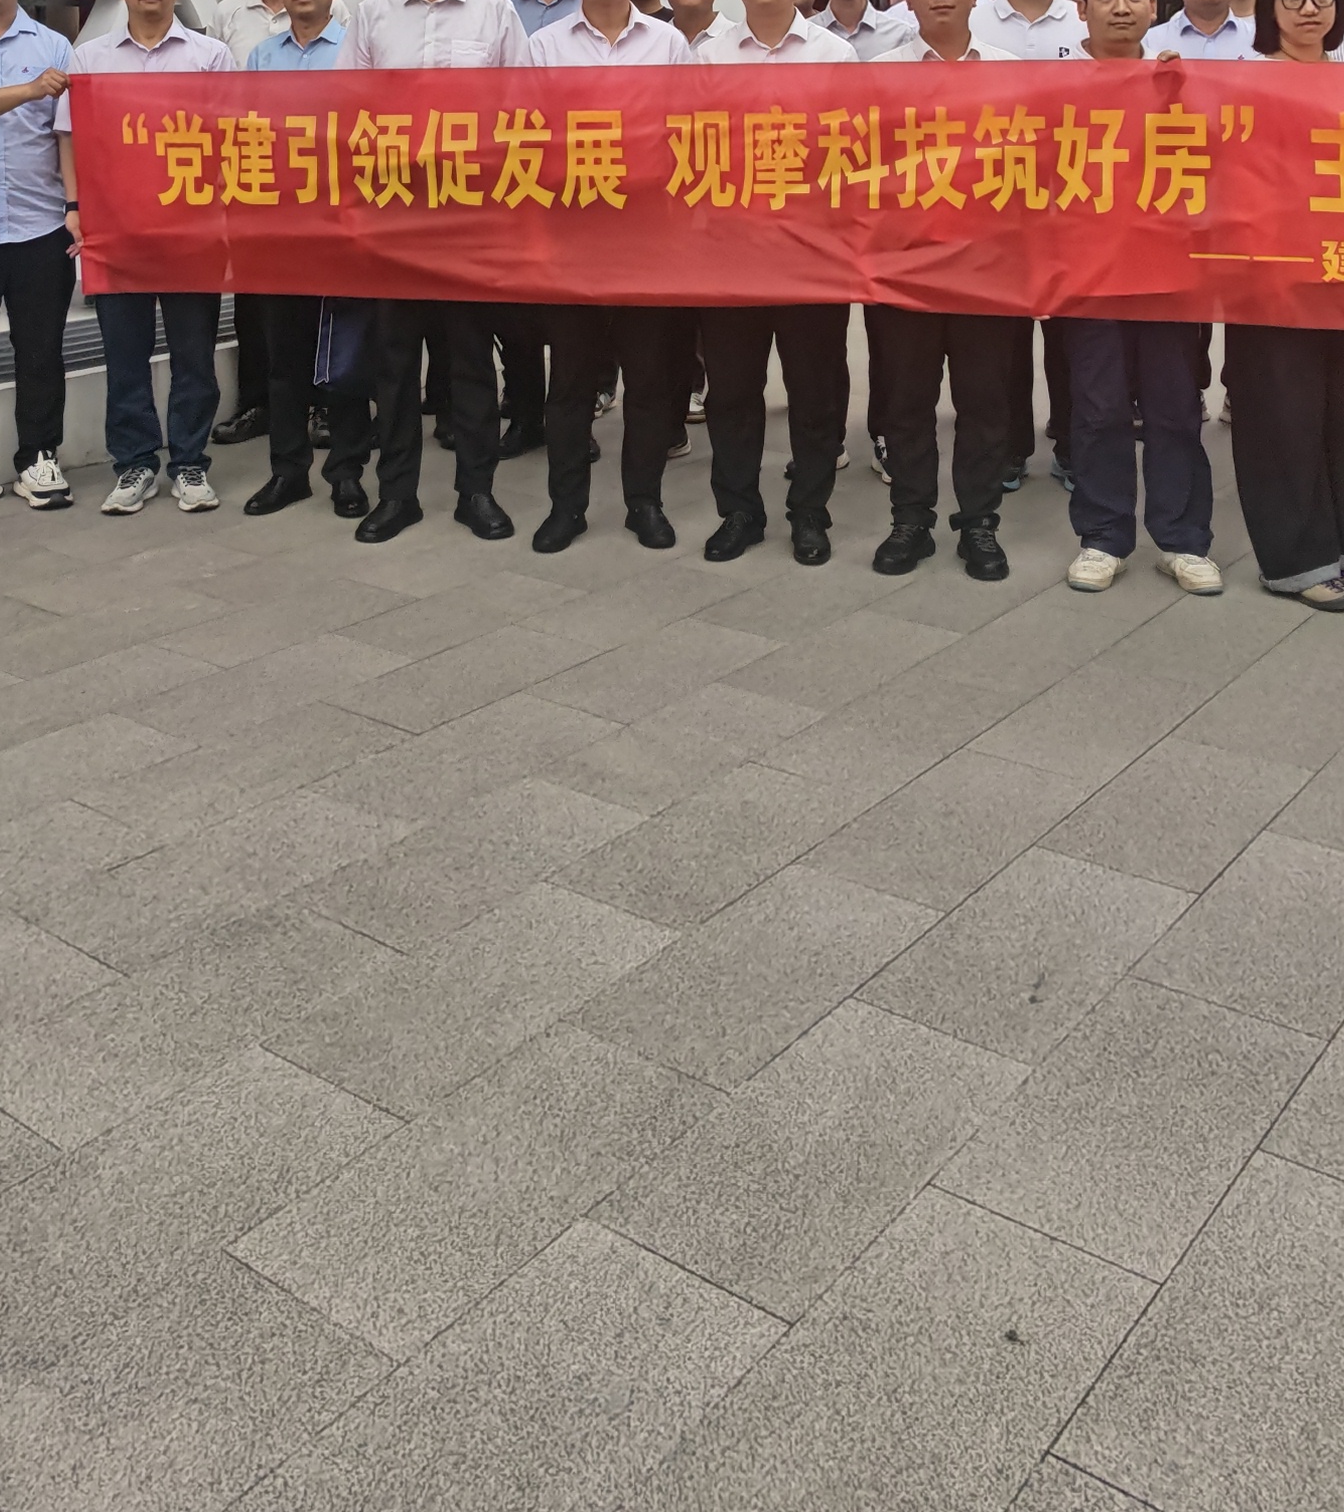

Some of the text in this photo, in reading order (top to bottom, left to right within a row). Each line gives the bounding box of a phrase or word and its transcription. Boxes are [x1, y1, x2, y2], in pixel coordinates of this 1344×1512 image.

[122, 108, 629, 210] “党建引领促发展
[664, 103, 1255, 216] 观摩科技筑好房”
